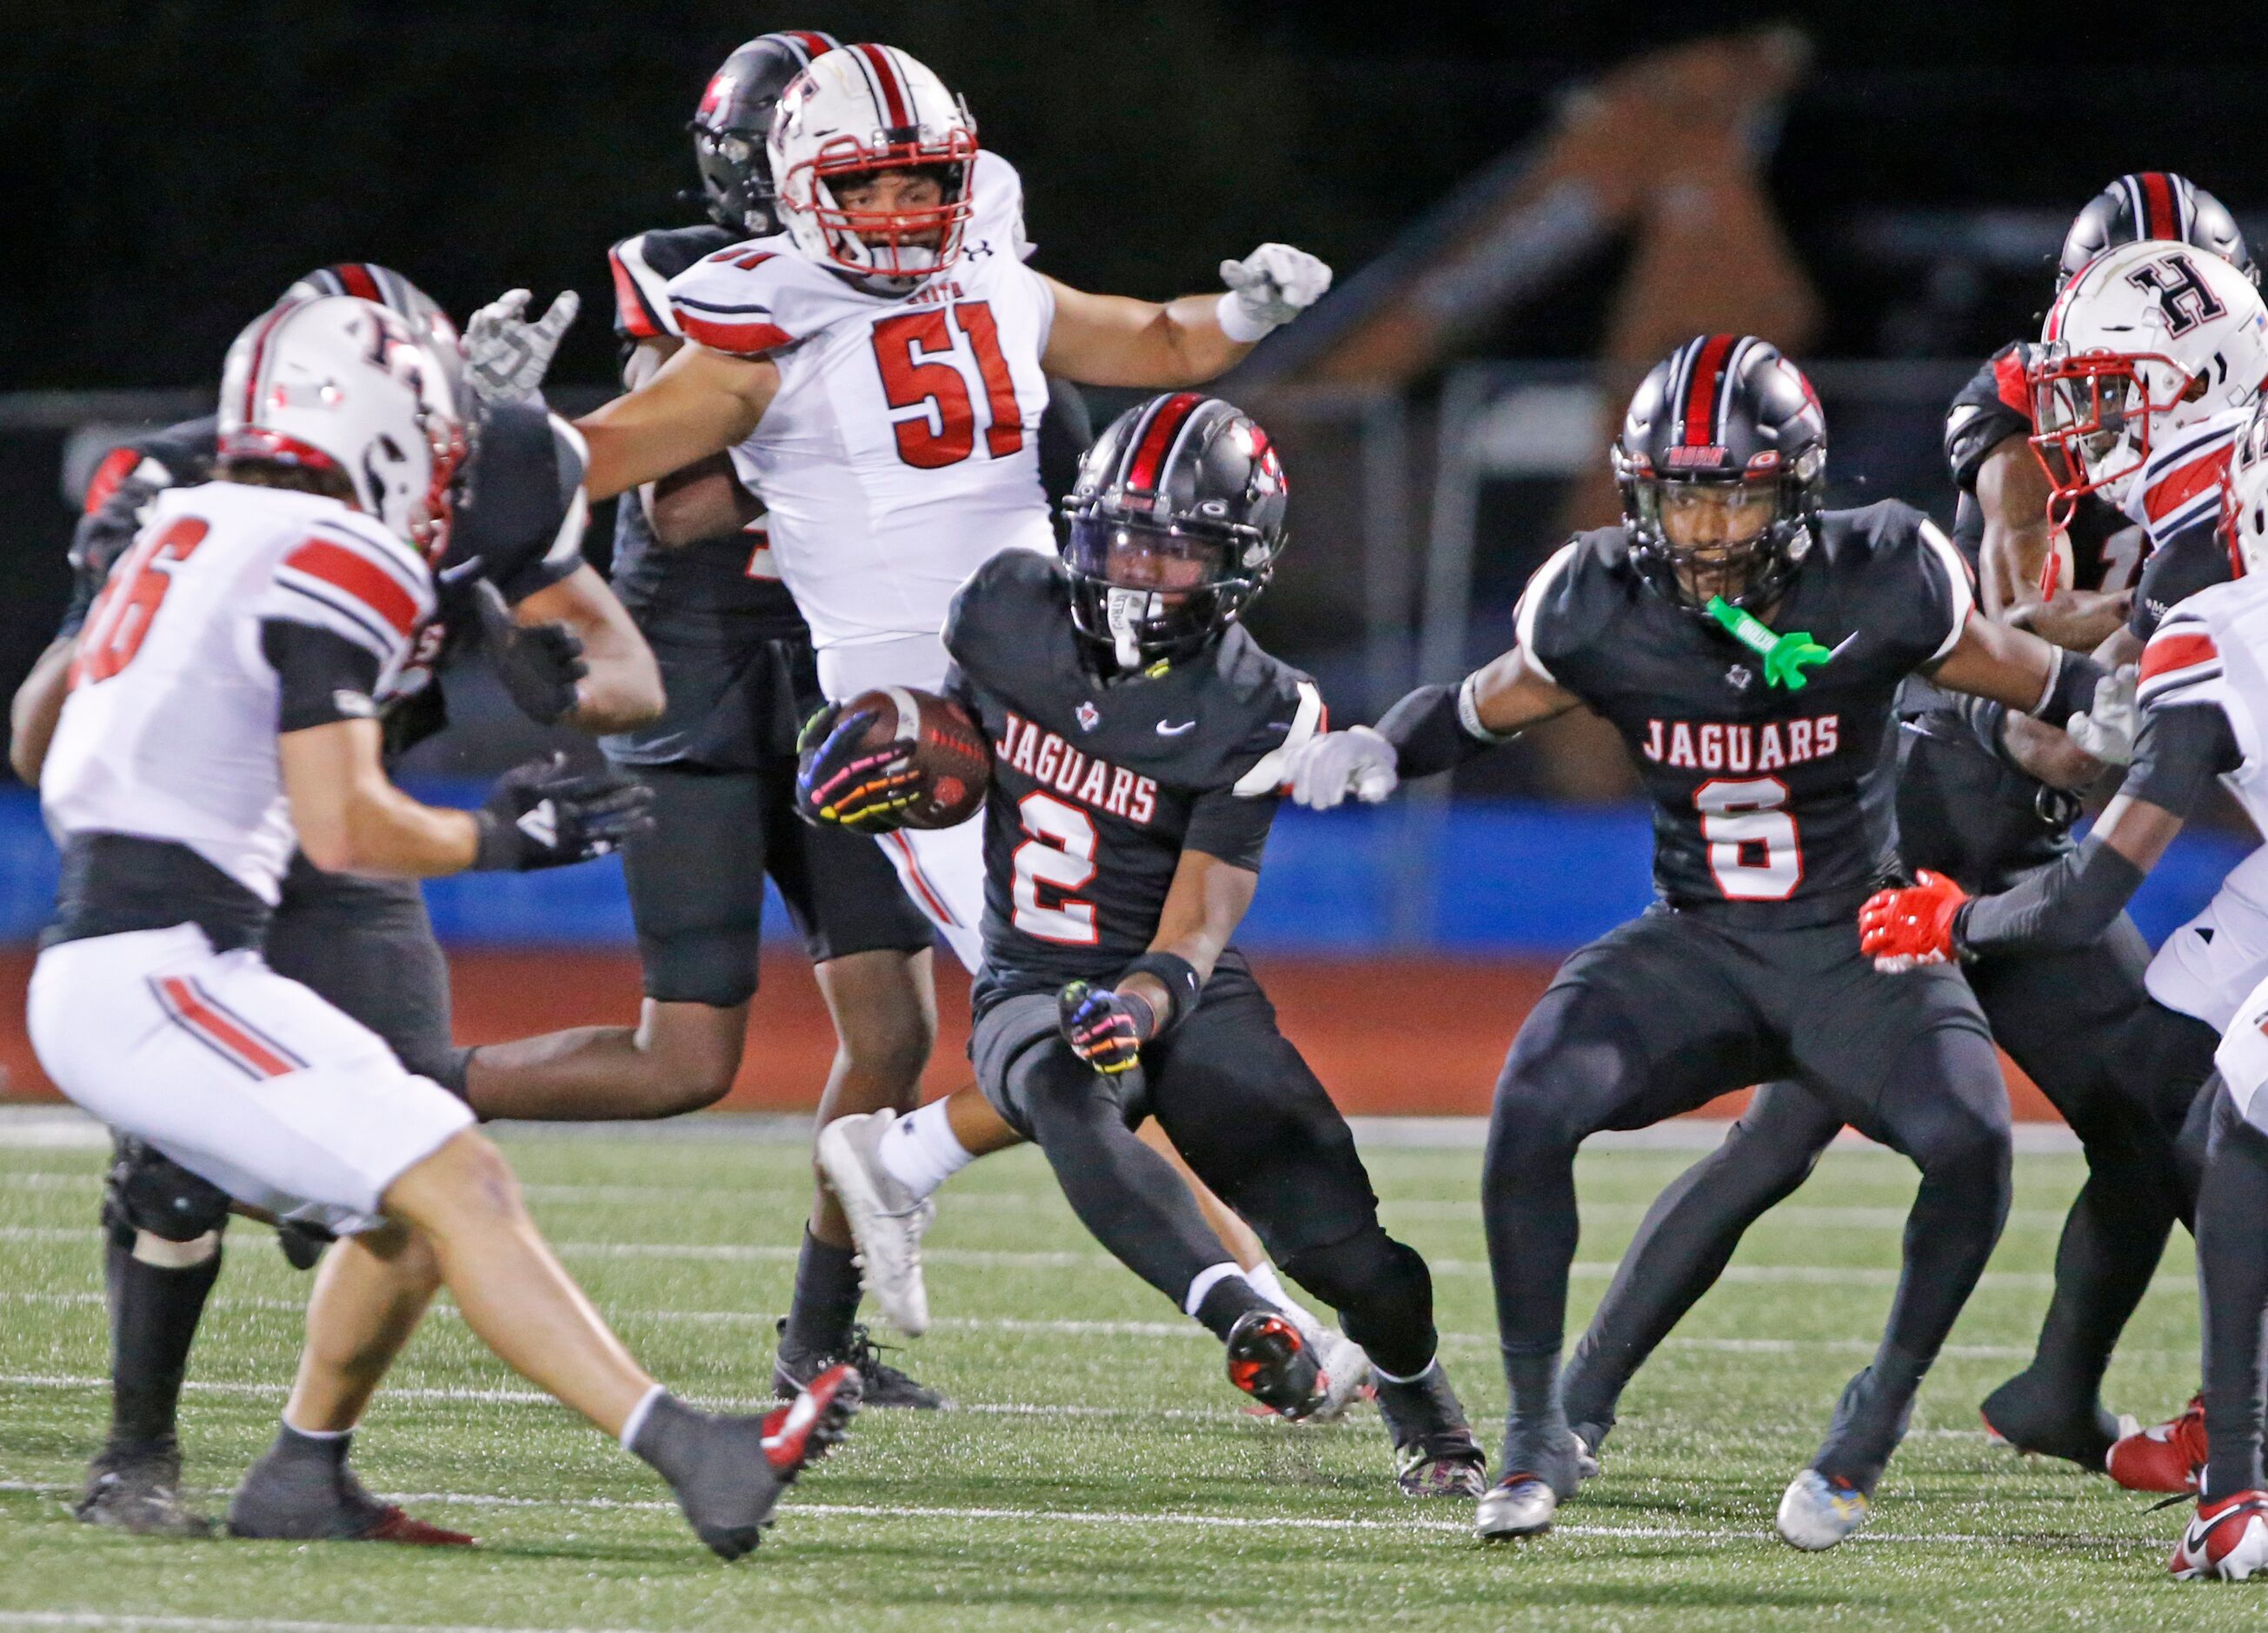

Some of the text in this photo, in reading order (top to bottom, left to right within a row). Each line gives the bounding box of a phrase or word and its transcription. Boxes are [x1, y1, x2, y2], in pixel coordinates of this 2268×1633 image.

[2125, 251, 2228, 340] H
[871, 300, 1024, 470] 51
[995, 710, 1158, 824] JAGUARS
[1642, 714, 1839, 772] JAGUARS
[1010, 790, 1100, 944] 2
[1693, 774, 1805, 902] 6
